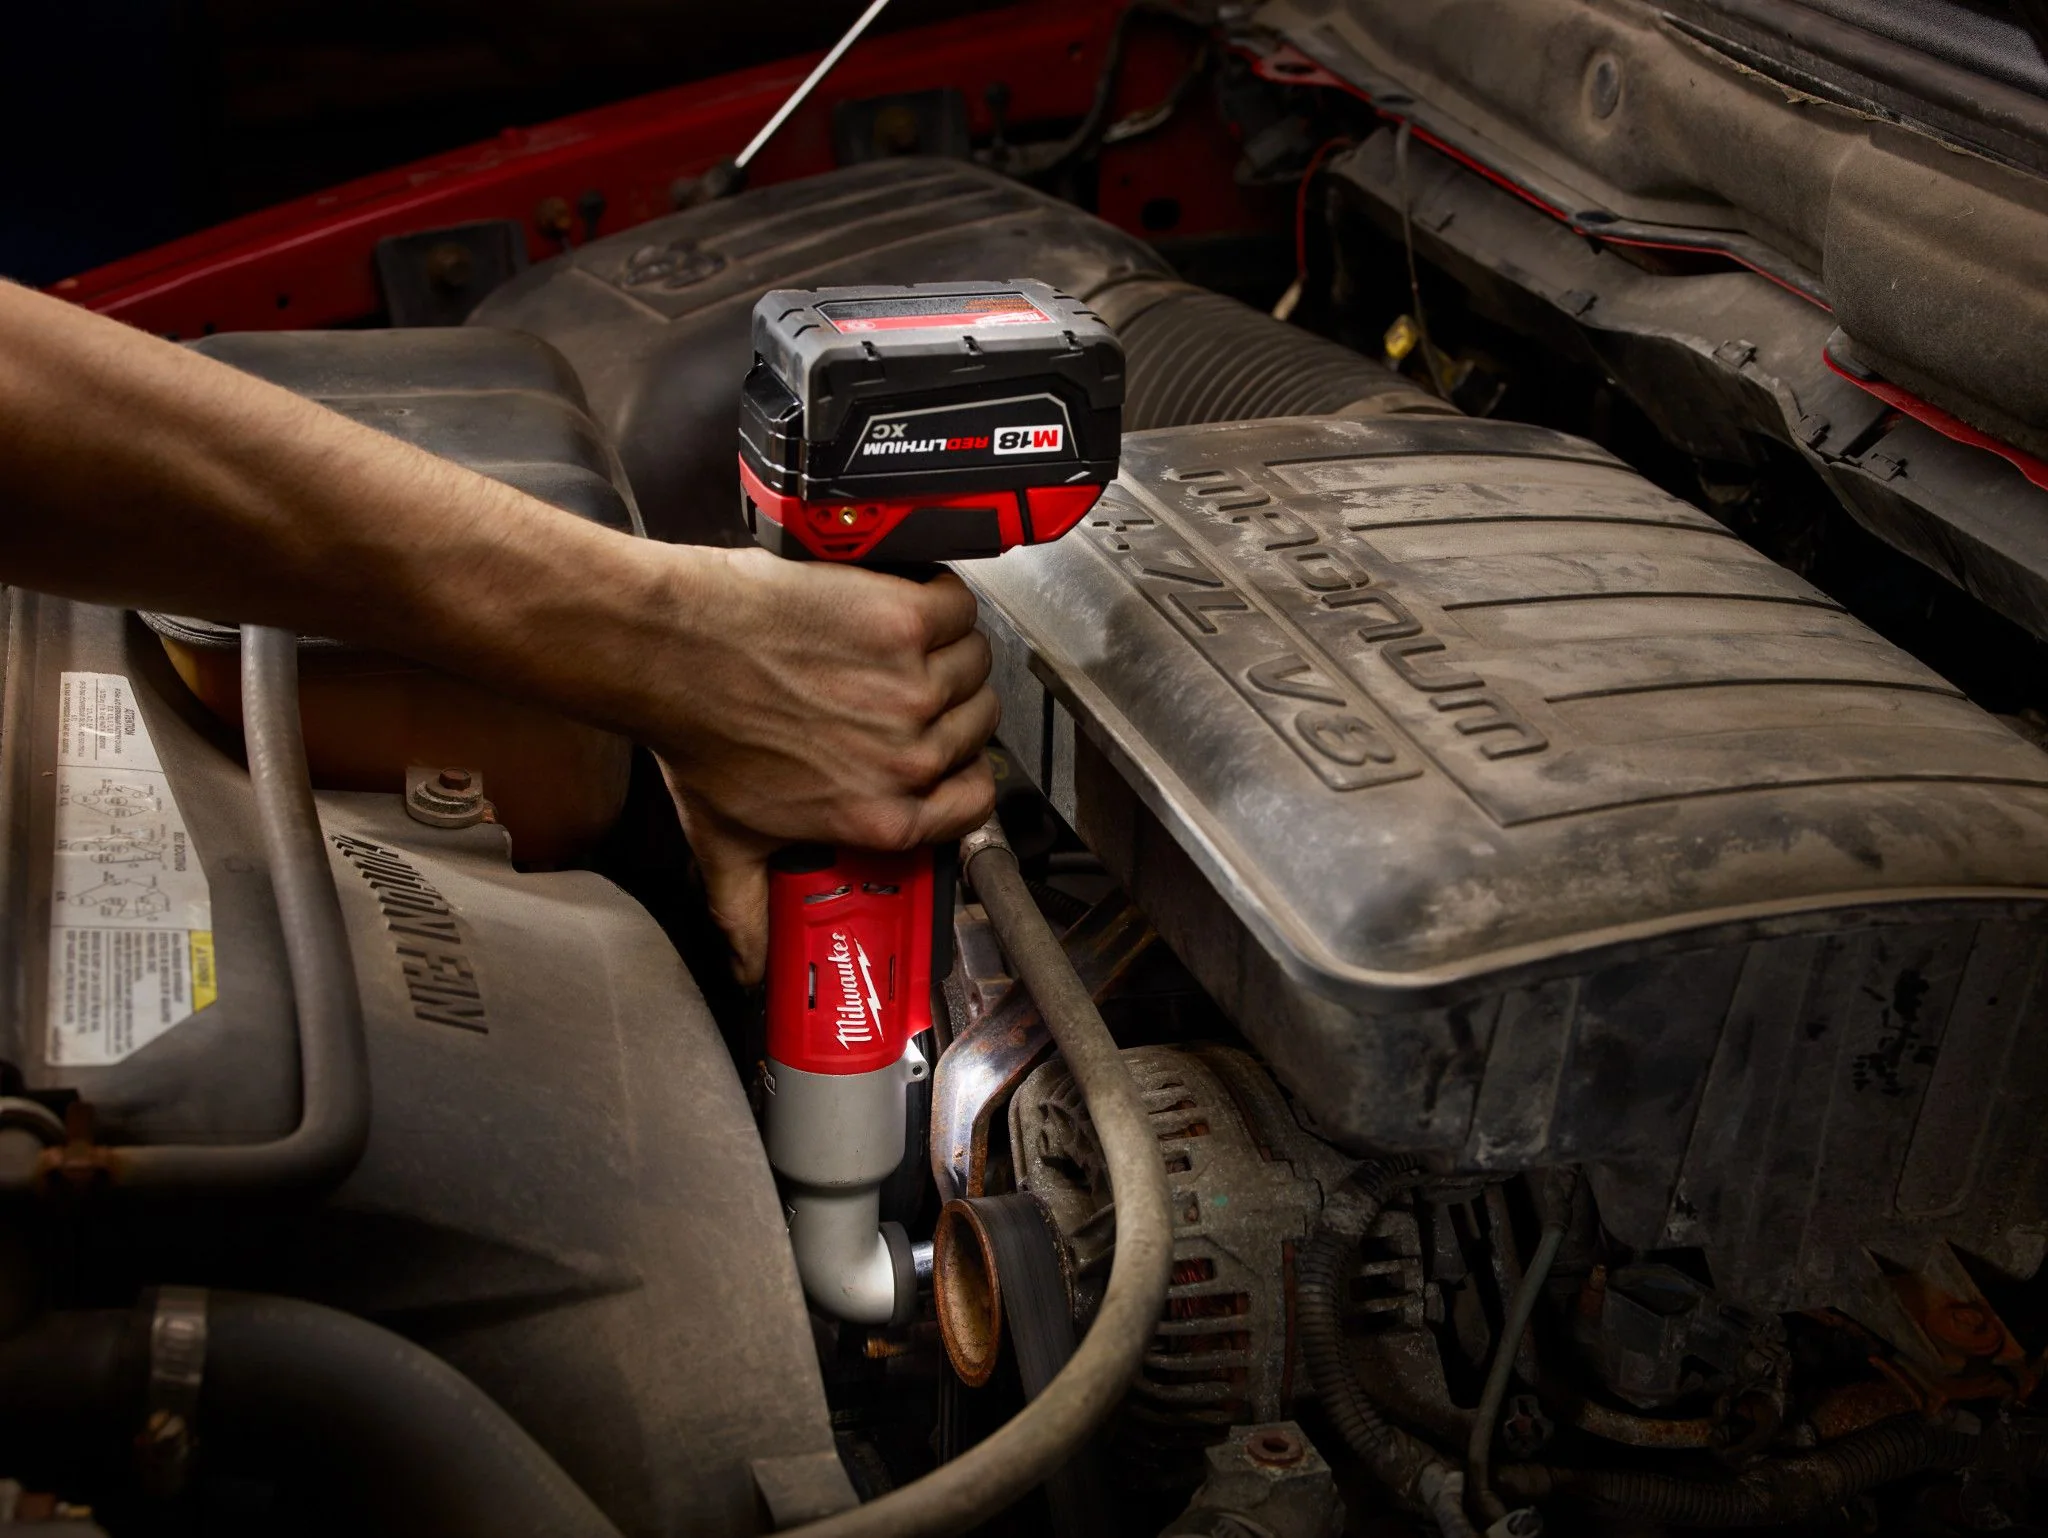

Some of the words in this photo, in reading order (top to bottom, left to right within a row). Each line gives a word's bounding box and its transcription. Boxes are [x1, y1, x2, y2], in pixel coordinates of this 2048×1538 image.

[862, 436, 989, 456] REDLITHIUM
[872, 423, 908, 439] XC
[998, 429, 1059, 450] M18
[1176, 467, 1550, 761] MAGNUM
[1246, 653, 1397, 767] V8
[395, 946, 489, 1034] FAN
[827, 932, 873, 1051] Milwaukee
